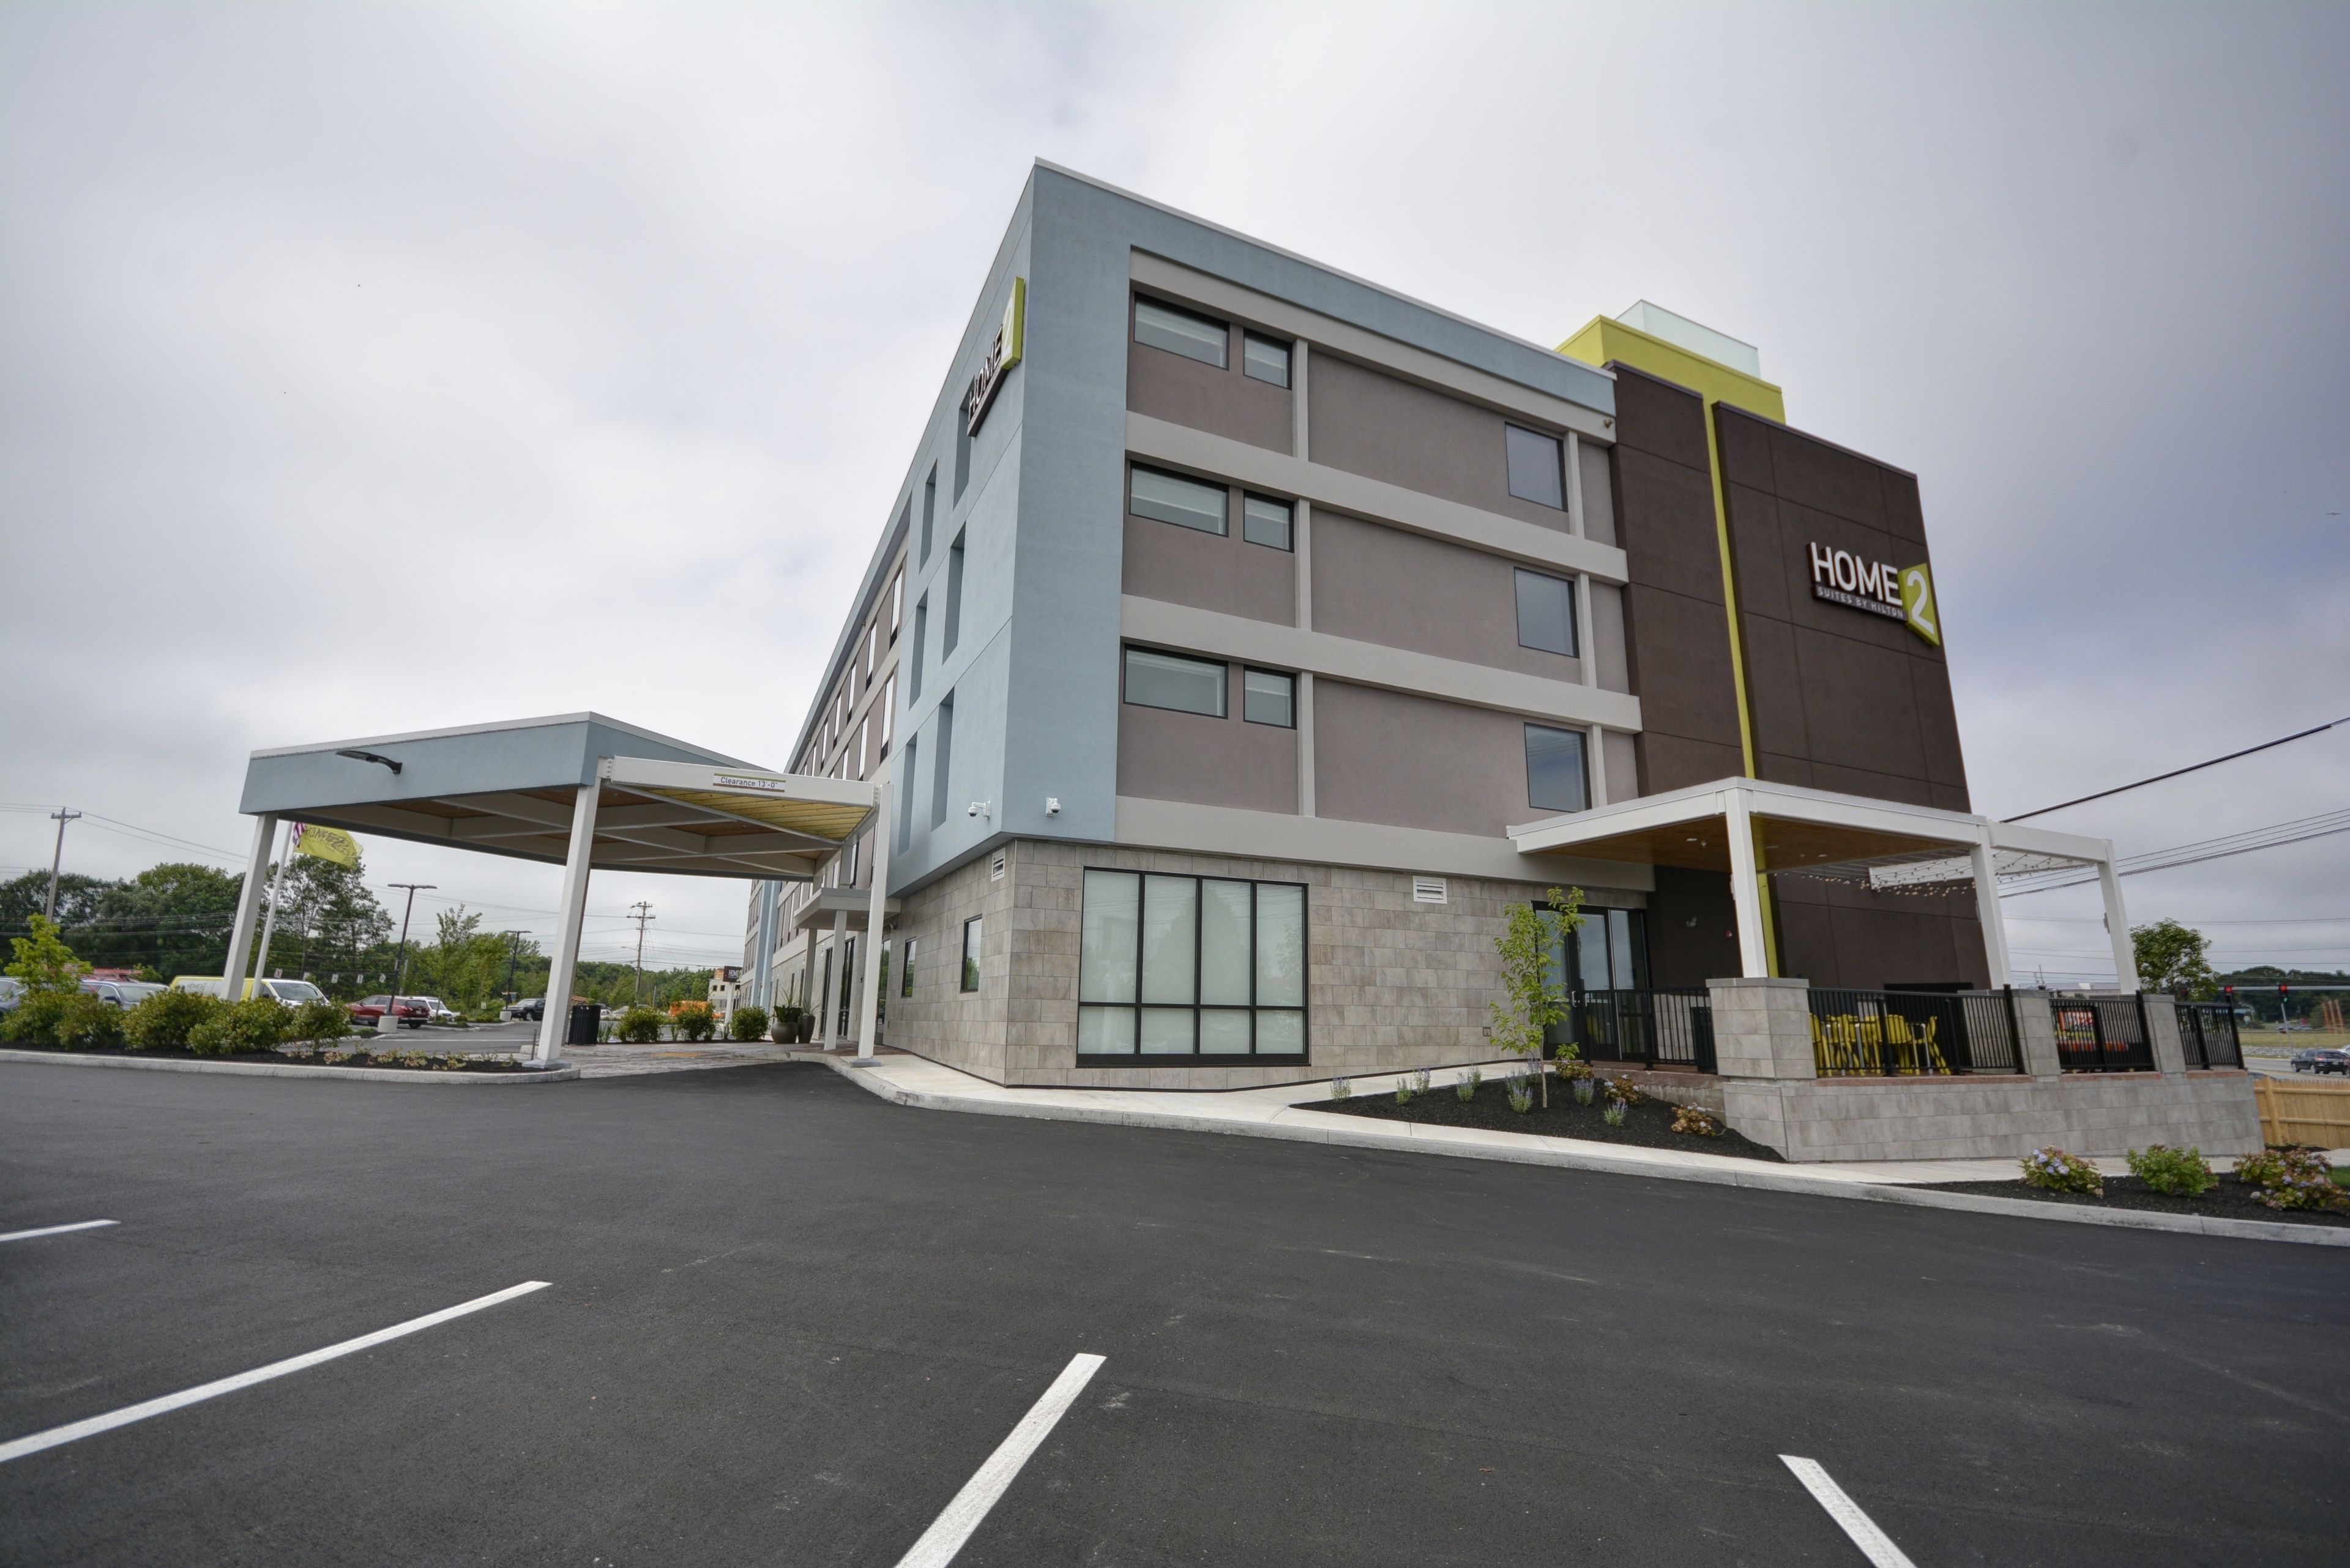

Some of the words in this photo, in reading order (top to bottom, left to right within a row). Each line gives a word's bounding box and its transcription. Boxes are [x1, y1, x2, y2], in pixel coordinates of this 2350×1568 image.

[968, 324, 1002, 422] HOME
[1002, 297, 1013, 358] 2
[1811, 542, 1902, 607] HOME
[1907, 570, 1935, 635] 2
[1818, 587, 1852, 604] SUITES
[1856, 599, 1867, 607] BY
[1871, 603, 1903, 618] HILTON
[720, 777, 756, 786] Clearance
